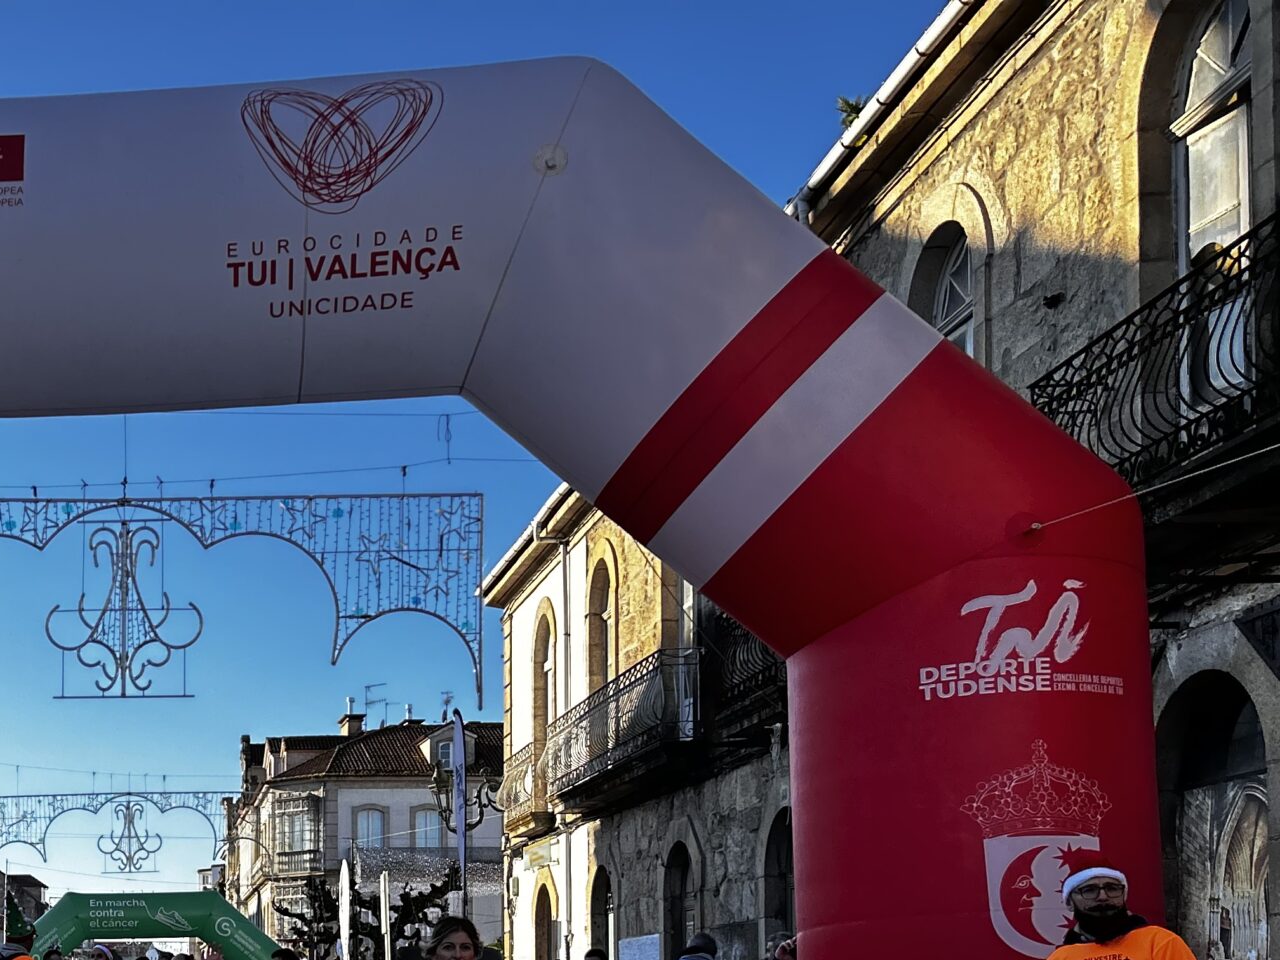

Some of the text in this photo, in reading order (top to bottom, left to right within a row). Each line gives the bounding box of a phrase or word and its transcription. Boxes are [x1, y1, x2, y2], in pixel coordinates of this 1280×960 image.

[227, 224, 463, 257] EUROCIDADE
[227, 259, 277, 287] TUI
[305, 246, 460, 281] VALENÇA
[270, 291, 414, 318] UNICIDADE
[919, 657, 1051, 684] DEPORTE
[918, 674, 1052, 701] TUDENSE
[1079, 684, 1108, 694] CONCELLO
[1108, 685, 1116, 694] DE
[89, 898, 146, 907] En marcha
[89, 909, 124, 918] contra
[89, 919, 140, 928] el cáncer
